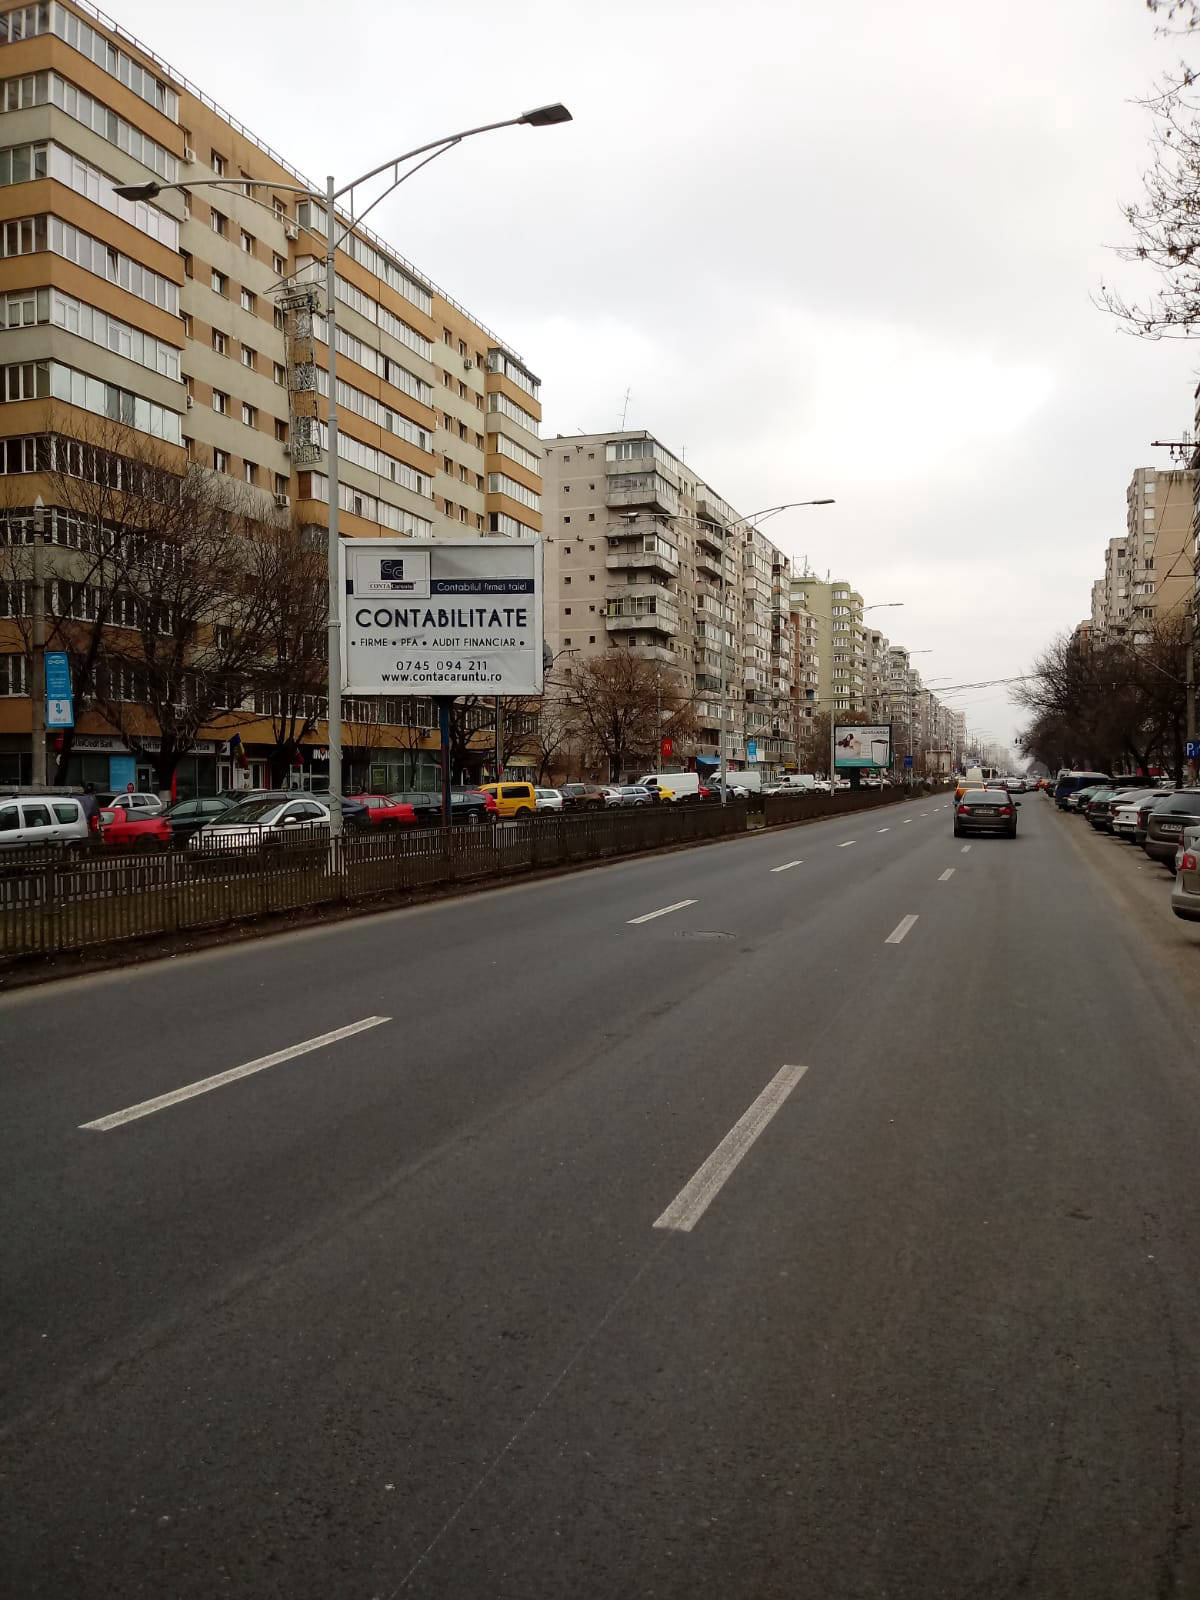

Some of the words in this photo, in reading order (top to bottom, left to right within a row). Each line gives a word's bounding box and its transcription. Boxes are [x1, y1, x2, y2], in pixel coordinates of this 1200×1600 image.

[437, 582, 482, 592] Contabilul
[484, 582, 506, 591] firmei
[355, 608, 527, 628] CONTABILITATE
[360, 637, 388, 647] FIRME
[400, 637, 418, 647] PFA
[432, 637, 460, 647] AUDIT
[463, 637, 516, 647] FINANCIAR
[396, 660, 430, 671] 0745
[436, 660, 462, 671] 094
[468, 660, 487, 671] 211
[382, 671, 502, 682] www.contacaruntu.ro
